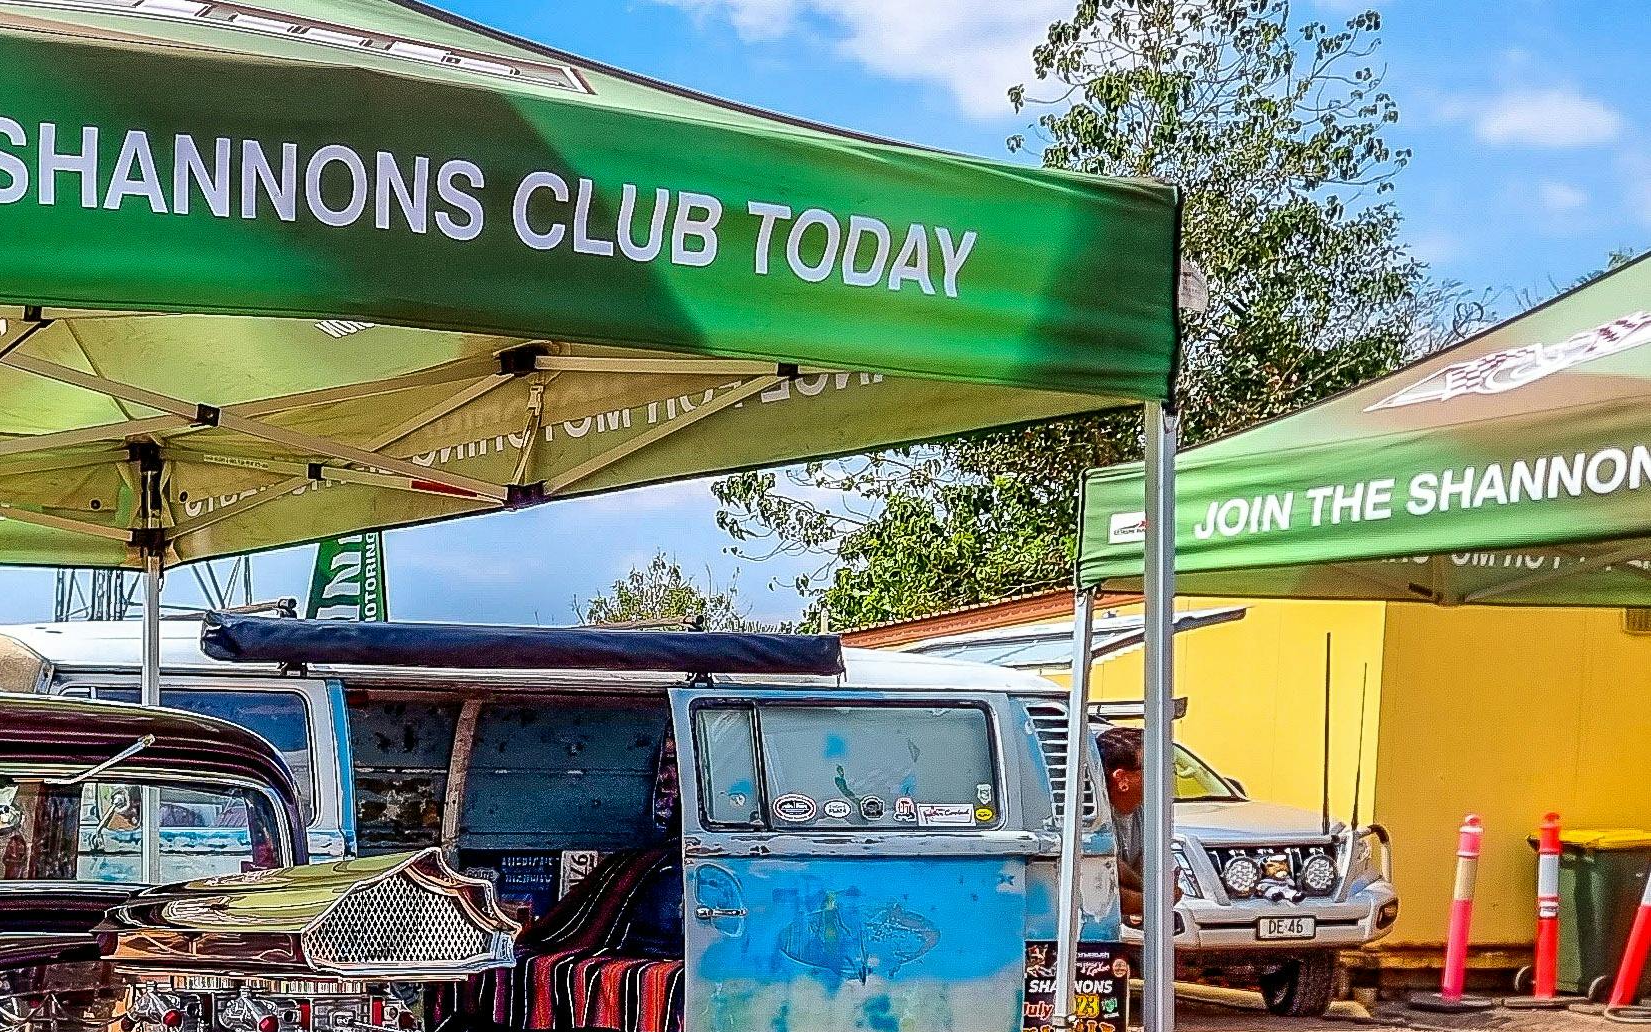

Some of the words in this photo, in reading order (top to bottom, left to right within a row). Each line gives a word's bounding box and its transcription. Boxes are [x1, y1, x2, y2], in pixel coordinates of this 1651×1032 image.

[512, 170, 725, 269] CLUB
[746, 199, 978, 300] TODAY
[1193, 491, 1295, 540] JOIN
[1305, 477, 1397, 528] THE
[1028, 979, 1114, 994] SHANONS
